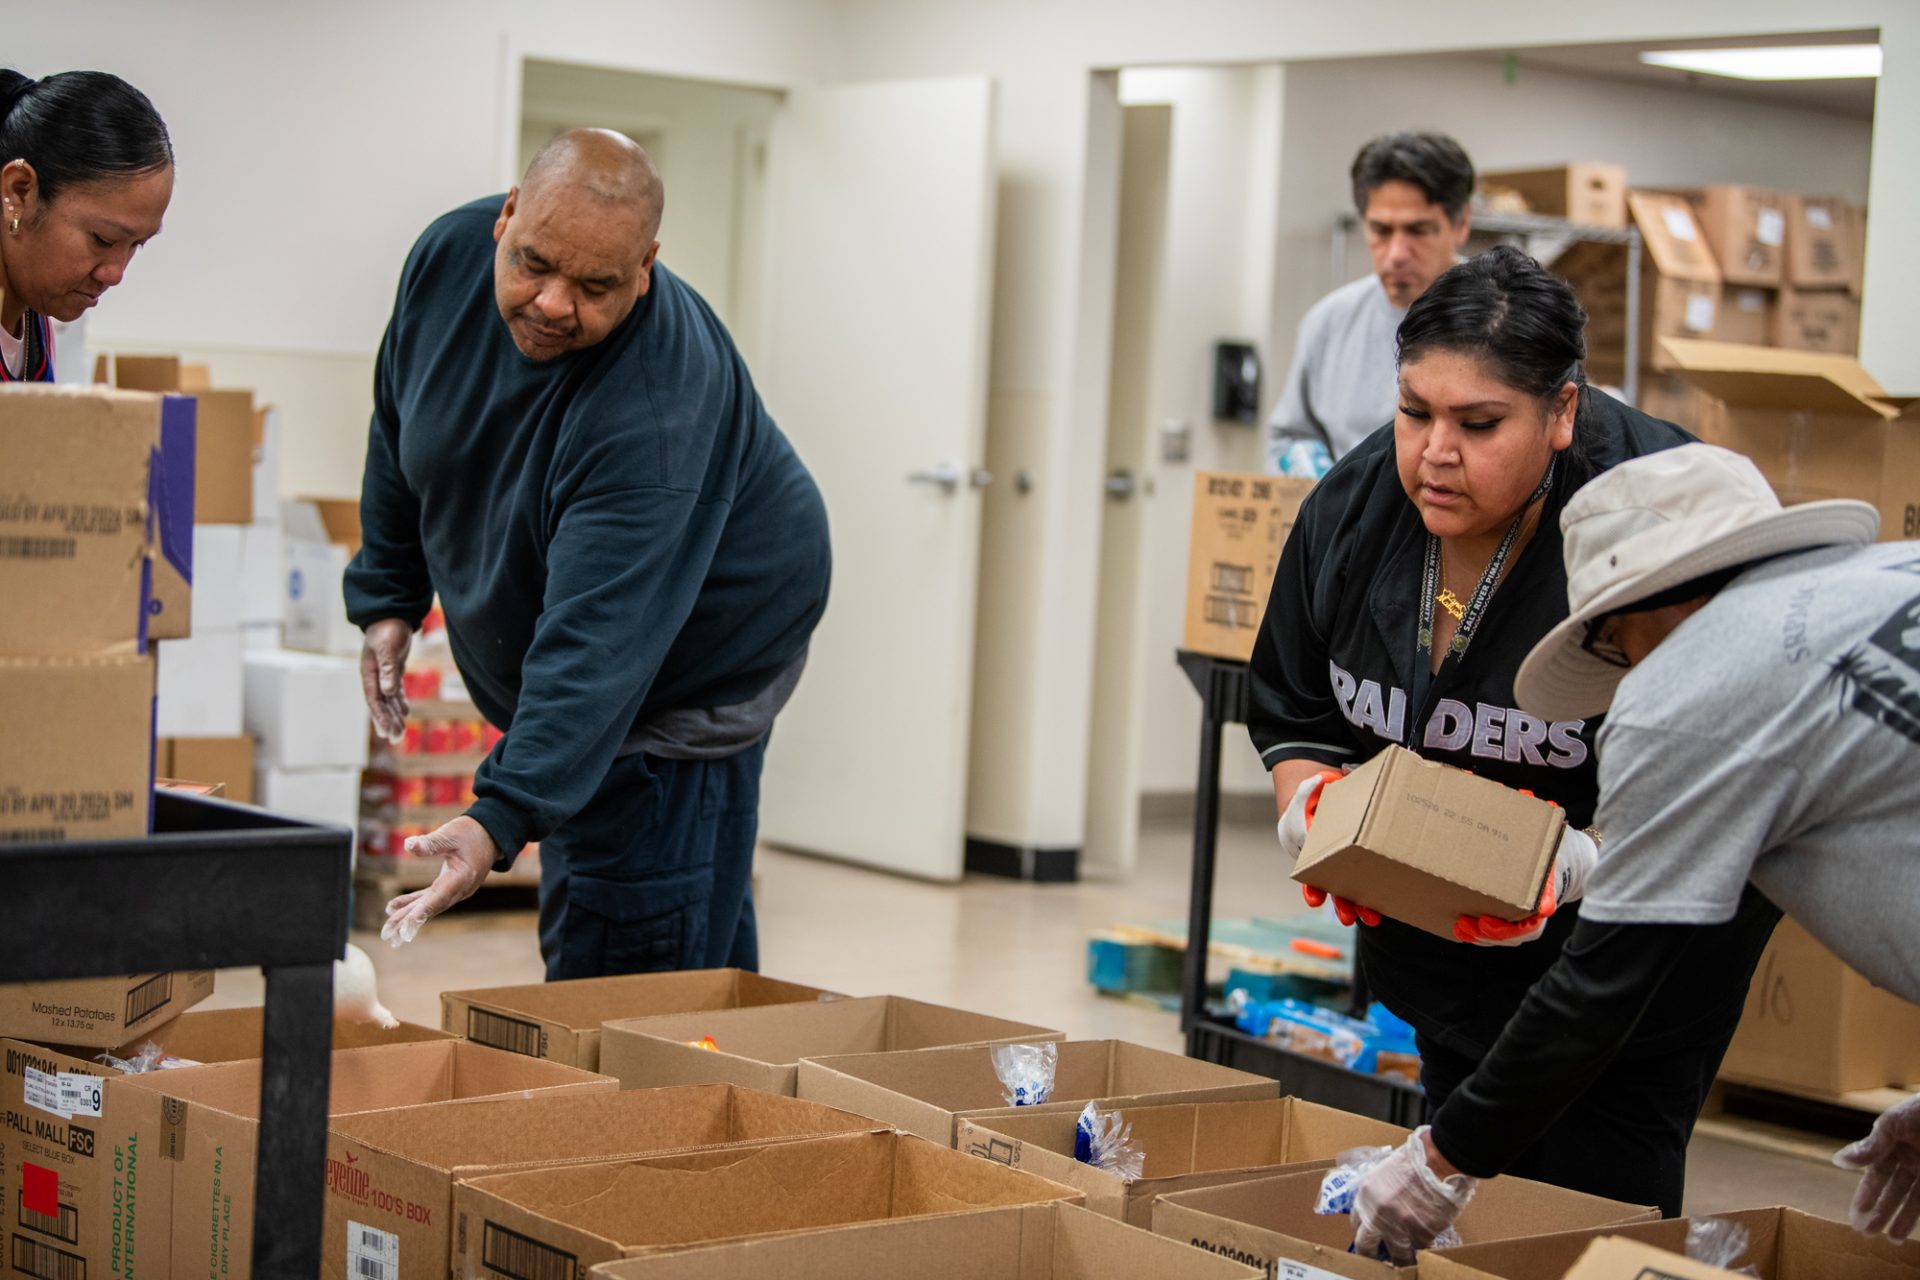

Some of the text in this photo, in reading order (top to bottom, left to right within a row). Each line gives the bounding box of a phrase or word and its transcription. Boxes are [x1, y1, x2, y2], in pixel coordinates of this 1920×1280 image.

[1424, 568, 1434, 623] COMMUNITY
[1463, 610, 1478, 632] SALT
[1473, 584, 1490, 610] RIVER
[32, 1002, 115, 1022] Mashed Potatoes
[52, 1018, 60, 1027] 12
[67, 1019, 85, 1029] 13.75
[85, 1022, 94, 1030] oz
[92, 1089, 101, 1111] 9
[7, 1110, 32, 1135] PALL
[35, 1119, 66, 1145] MALL
[69, 1130, 93, 1154] FSC
[22, 1140, 75, 1165] SELECT BLUE BOX
[215, 1146, 223, 1156] A
[214, 1159, 222, 1174] IN
[325, 1159, 369, 1201] eyenne
[112, 1145, 124, 1272] PRODUCT OF
[125, 1131, 138, 1280] NTERNATIONAL
[210, 1176, 221, 1268] CIGARETTES
[371, 1189, 403, 1216] 100'S
[407, 1202, 431, 1226] BOX
[221, 1194, 231, 1274] DRY PLACE
